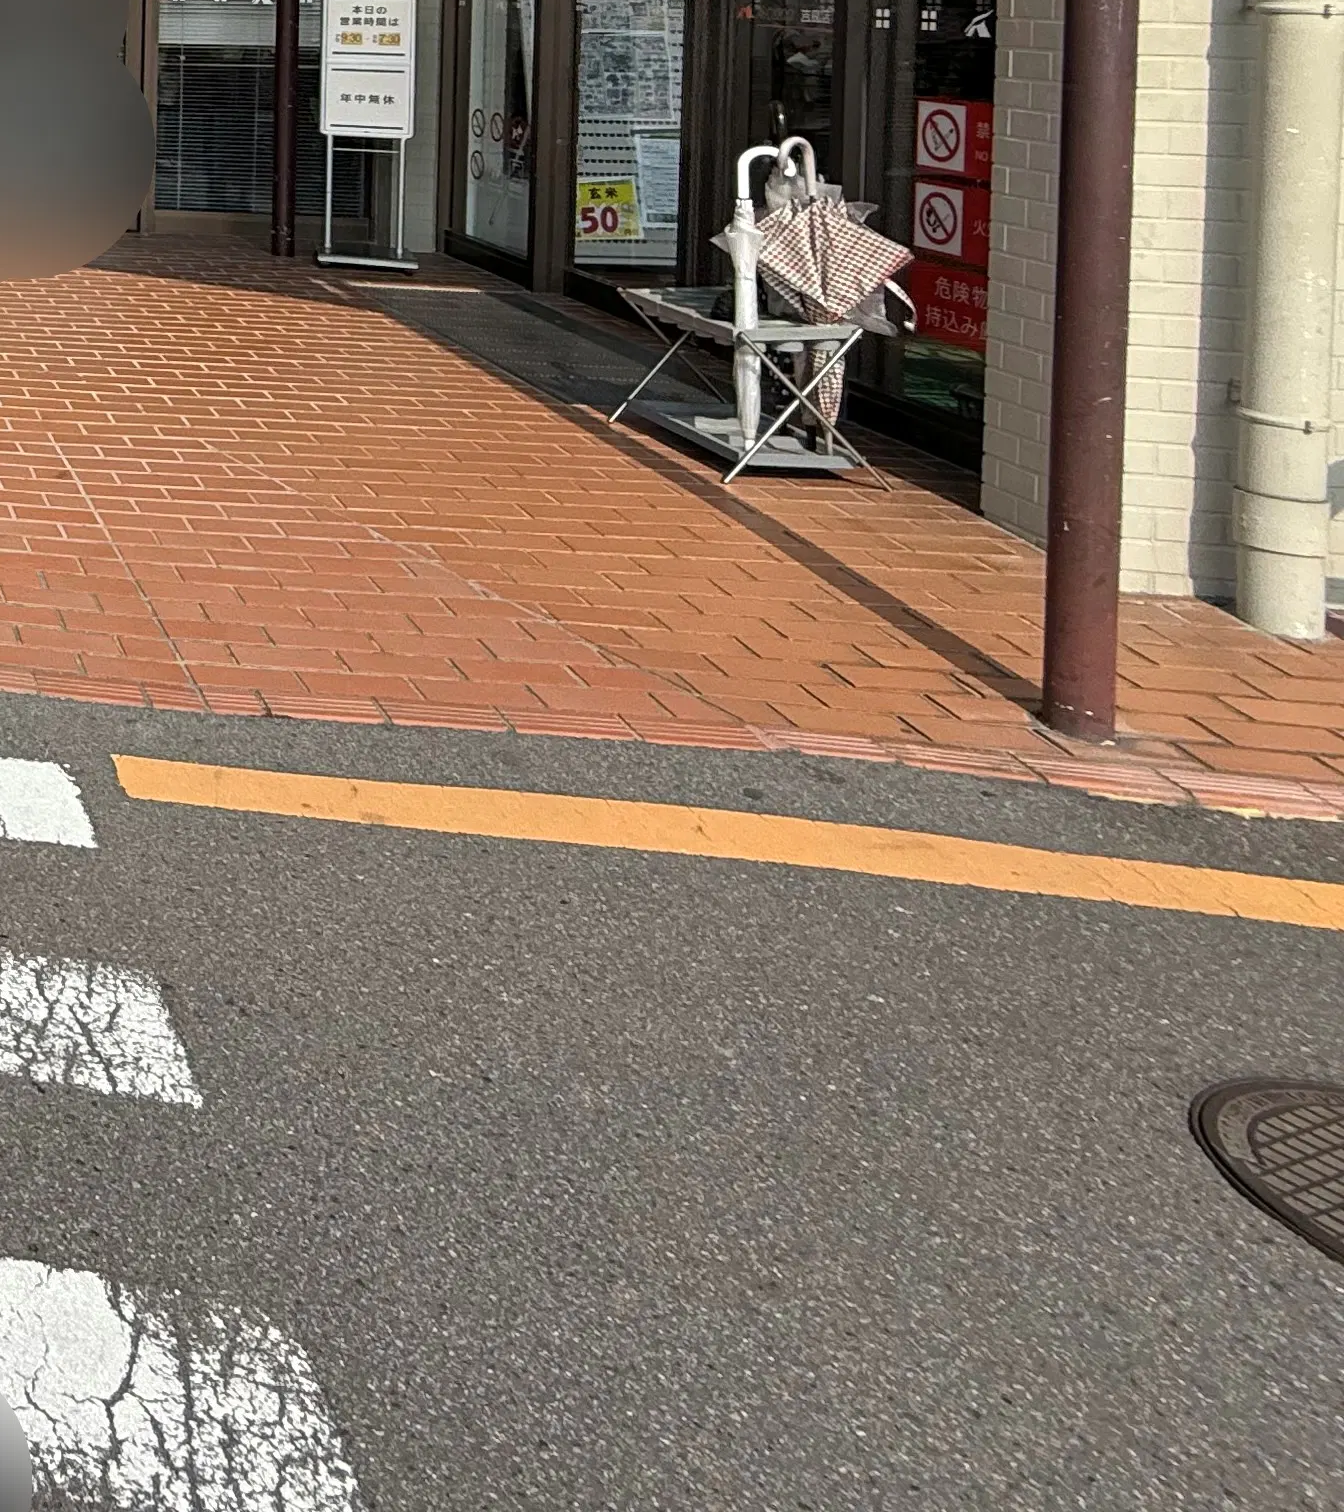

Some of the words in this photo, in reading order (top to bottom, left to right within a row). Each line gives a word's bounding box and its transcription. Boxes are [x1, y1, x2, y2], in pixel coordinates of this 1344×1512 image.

[352, 5, 388, 15] 本日の
[339, 17, 399, 26] 営業時間は
[340, 93, 395, 105] 年中無休
[580, 206, 619, 233] 50
